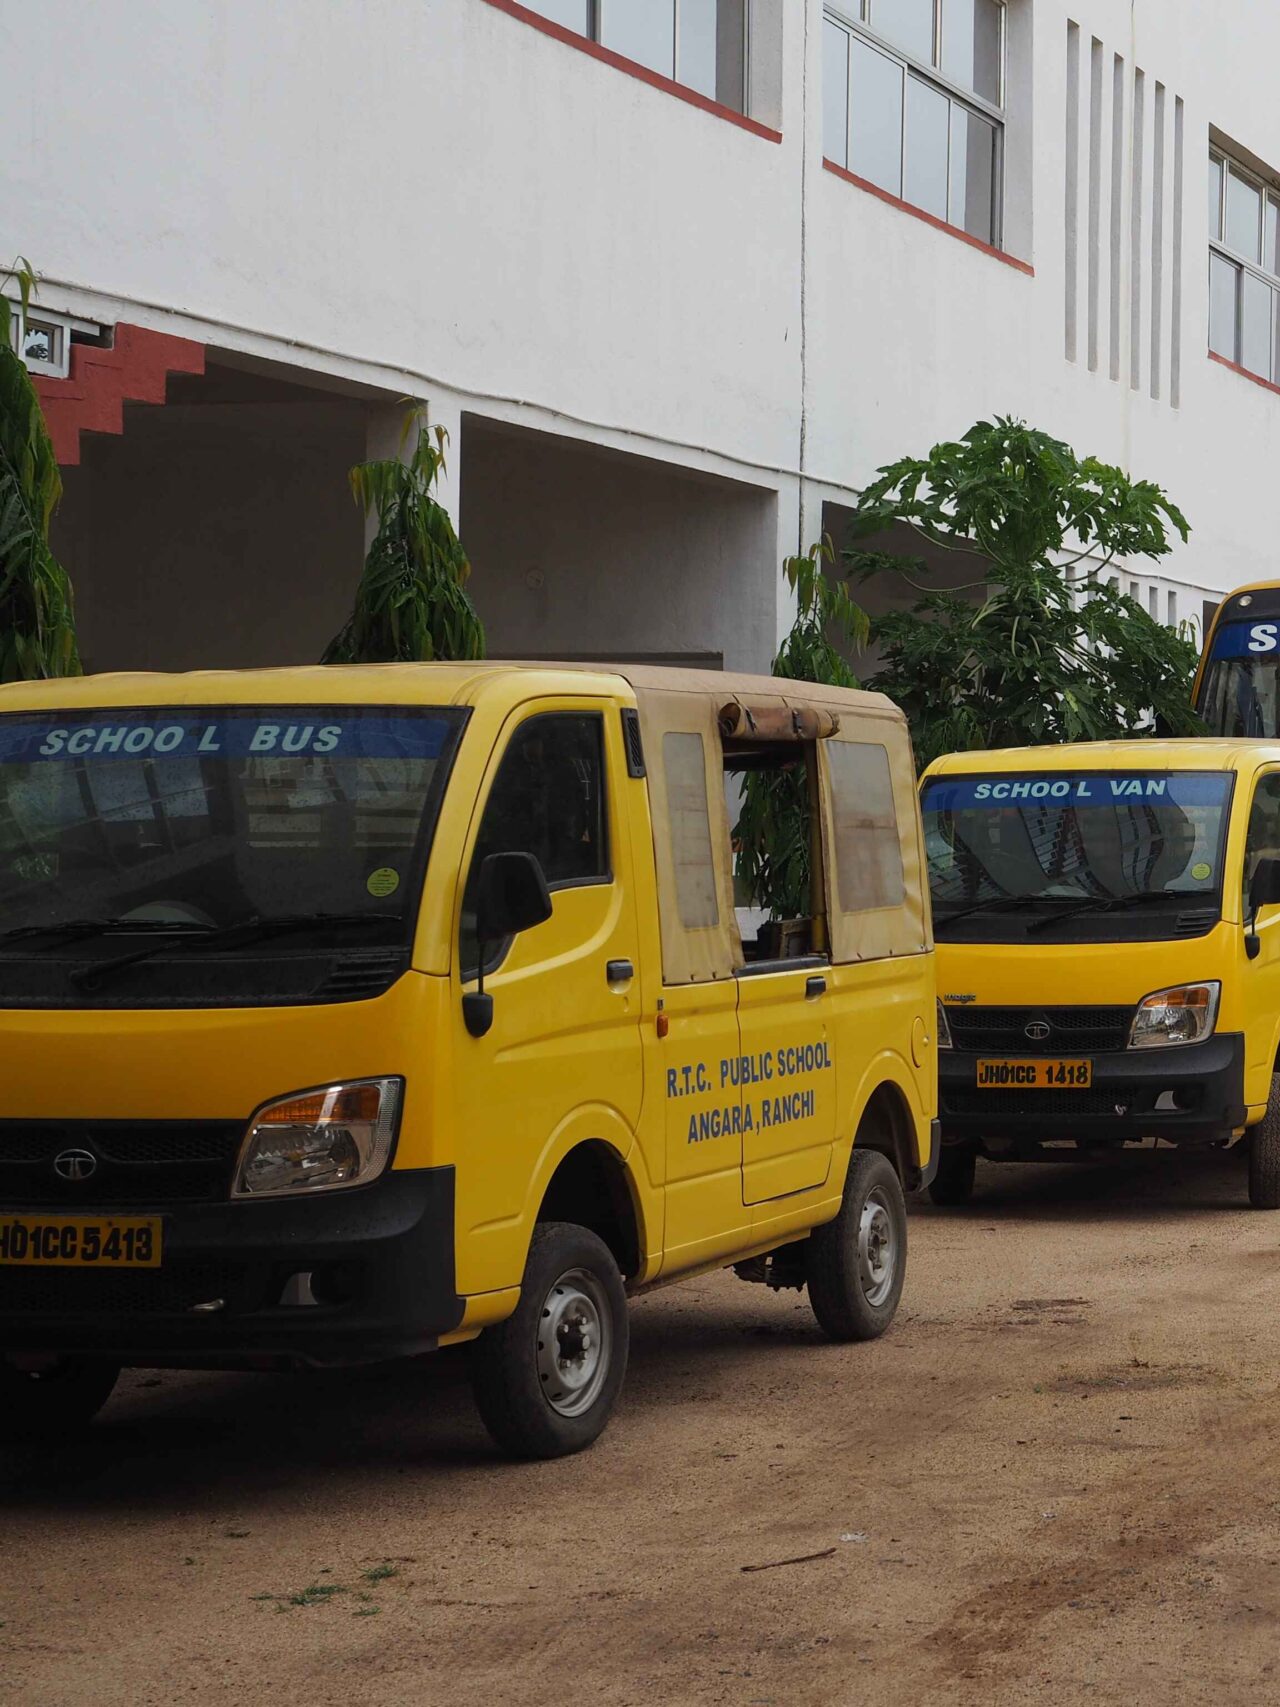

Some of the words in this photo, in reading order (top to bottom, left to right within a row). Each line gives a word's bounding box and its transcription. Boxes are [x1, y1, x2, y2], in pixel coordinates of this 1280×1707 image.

[249, 725, 342, 752] BUS
[1109, 780, 1166, 796] VAN
[667, 1063, 711, 1098] R.T.C.
[720, 1052, 773, 1088] PUBLIC
[778, 1042, 831, 1076] SCHOOL
[979, 1065, 1036, 1084] JH01CC
[1046, 1065, 1088, 1084] 1418
[762, 1090, 814, 1128] RANCHI
[81, 1227, 153, 1261] 5413
